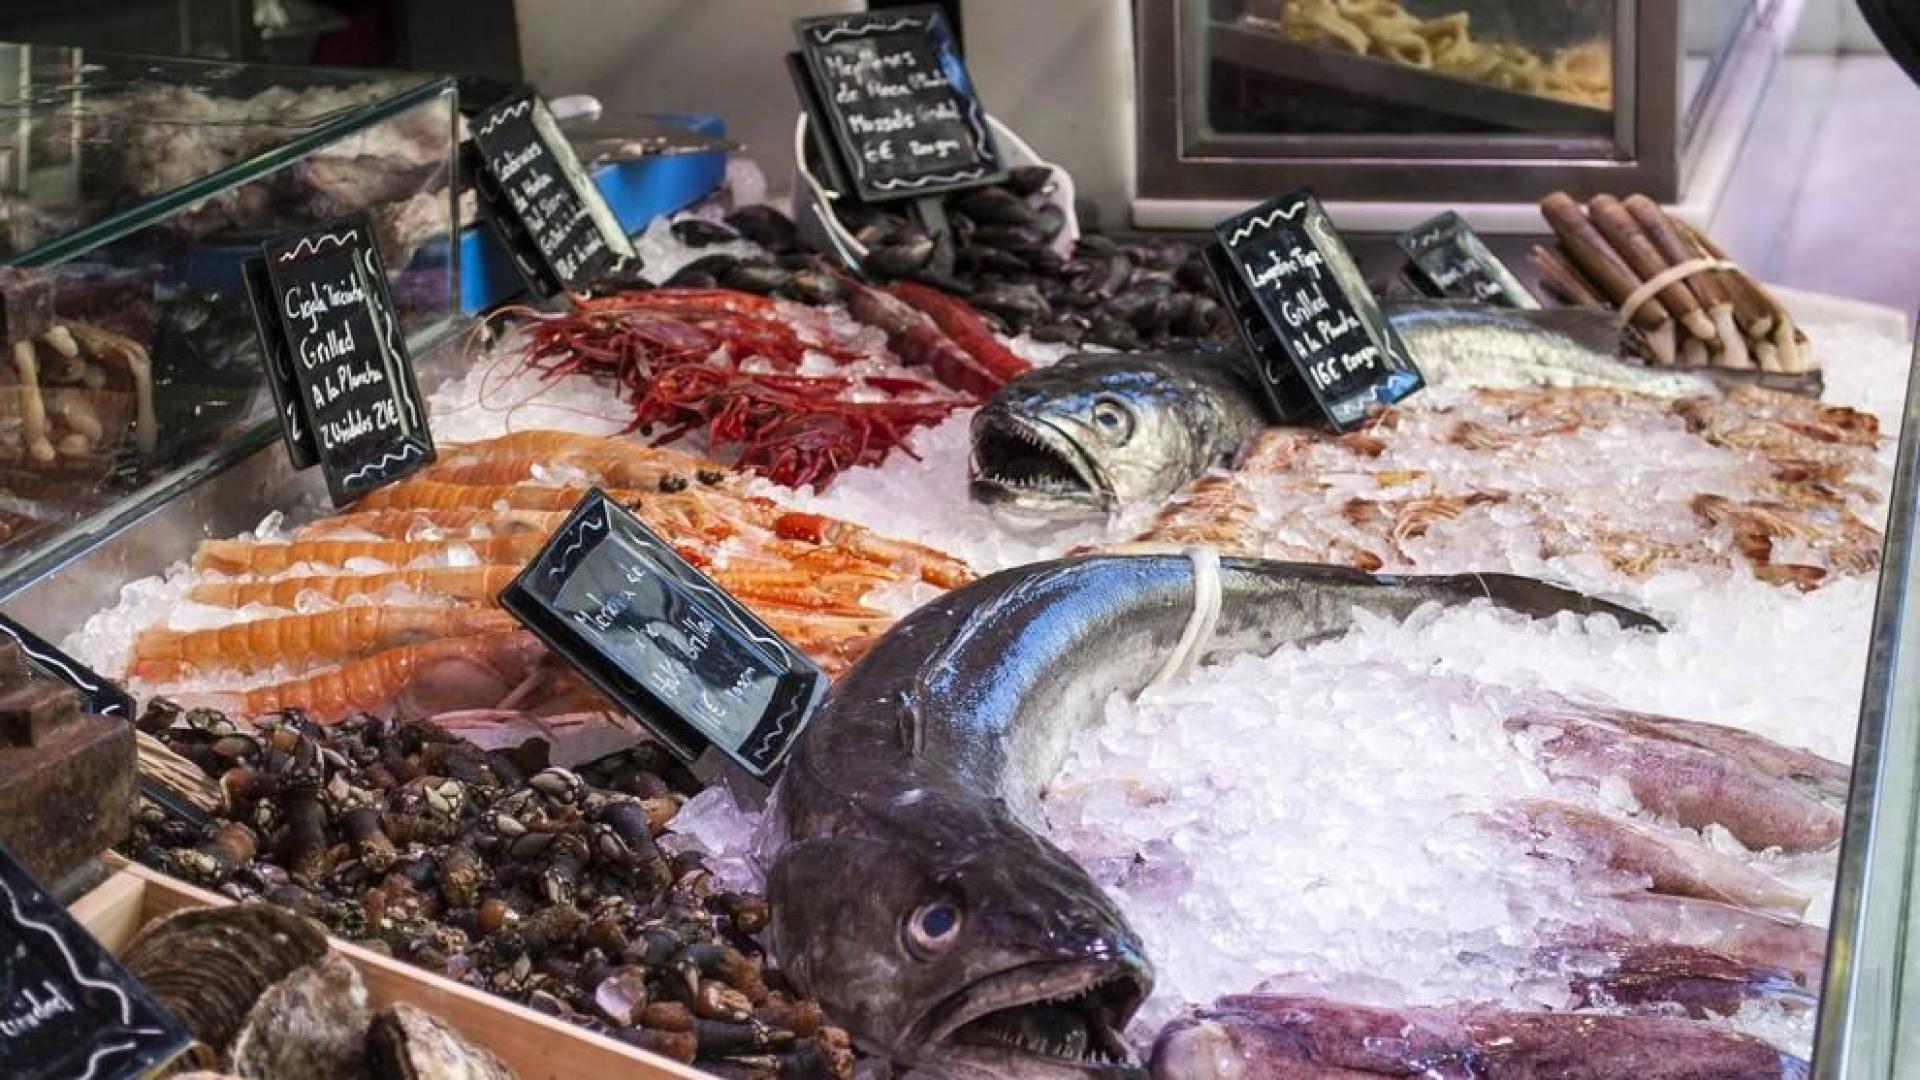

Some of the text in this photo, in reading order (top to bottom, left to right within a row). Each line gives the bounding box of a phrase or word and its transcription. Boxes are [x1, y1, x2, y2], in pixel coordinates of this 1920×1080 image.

[1282, 281, 1330, 327] Grilled
[301, 319, 355, 369] Grilled
[312, 384, 324, 409] A
[325, 376, 340, 401] la
